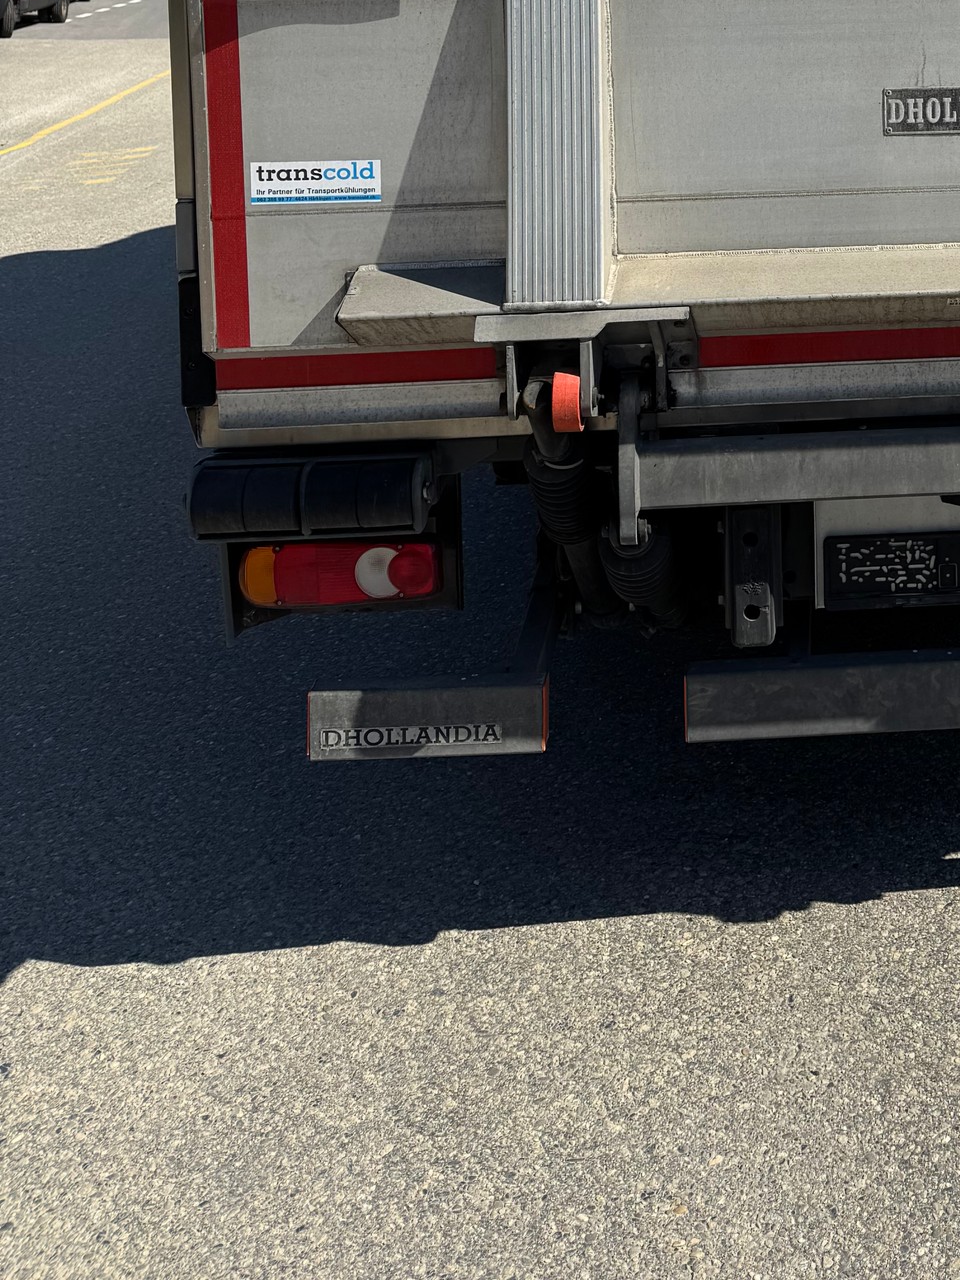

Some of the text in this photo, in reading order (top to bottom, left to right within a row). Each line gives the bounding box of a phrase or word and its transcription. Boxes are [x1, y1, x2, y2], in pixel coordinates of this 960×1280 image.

[256, 161, 376, 182] transcold
[295, 187, 305, 195] für
[307, 186, 376, 195] Transportkühlungen
[321, 724, 500, 748] DHOLLANDIA
